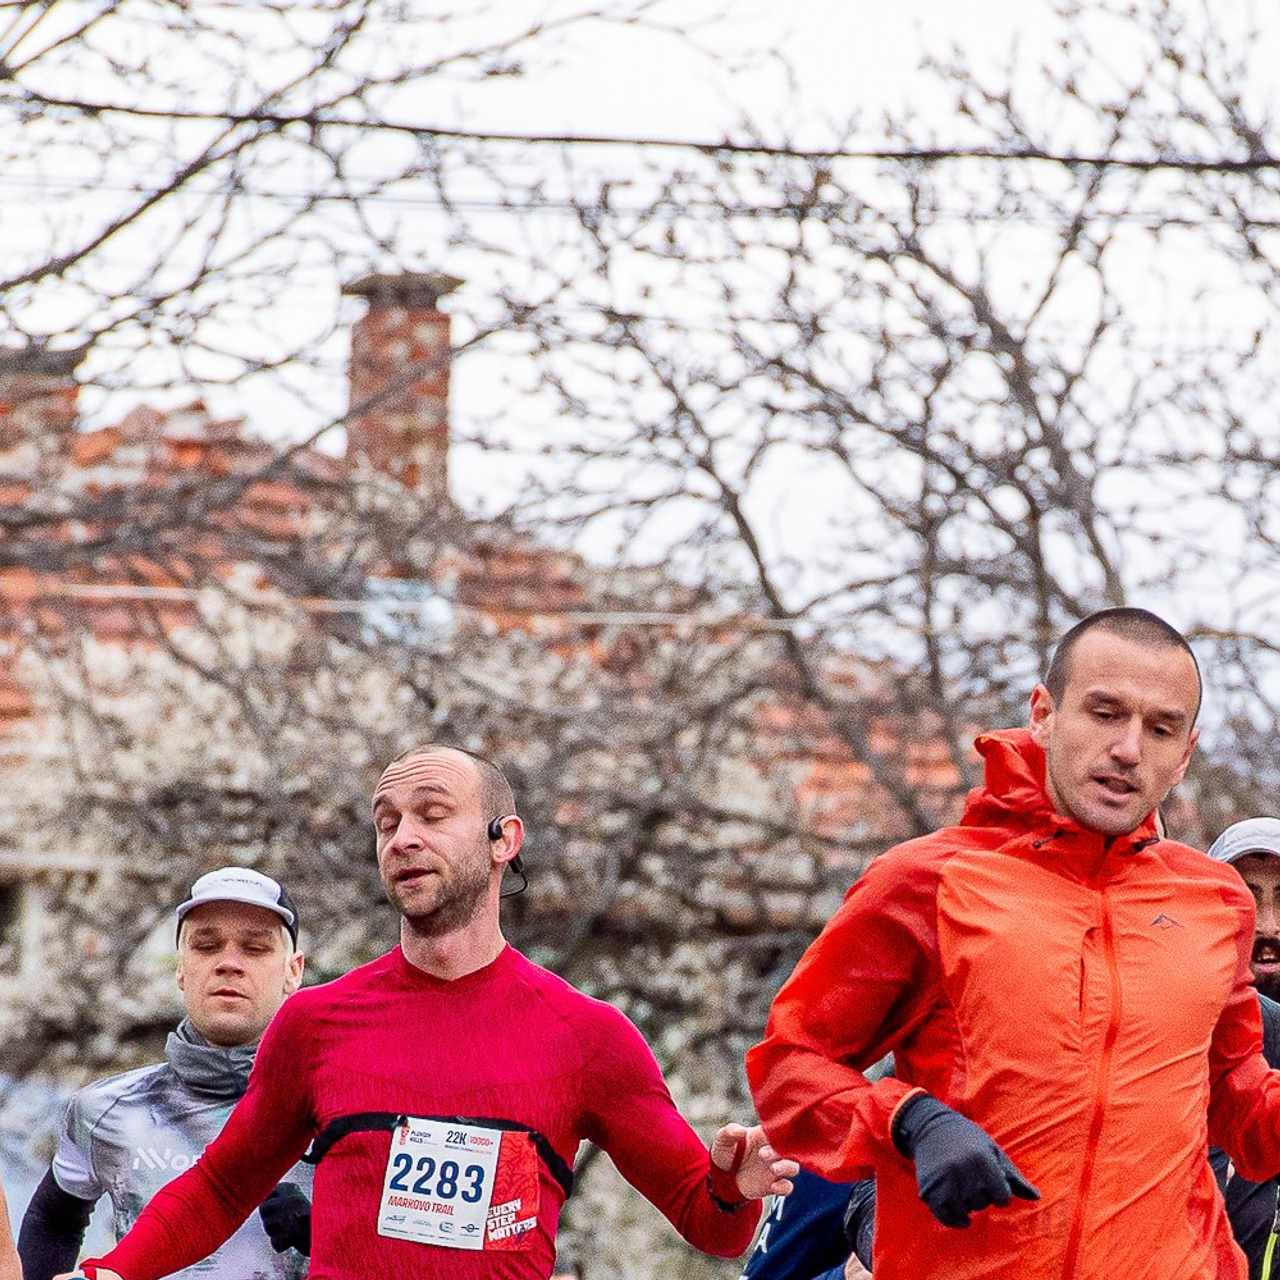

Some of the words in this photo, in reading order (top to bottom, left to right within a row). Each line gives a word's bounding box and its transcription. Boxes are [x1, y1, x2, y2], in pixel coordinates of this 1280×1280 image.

[446, 1130, 467, 1146] 22K
[389, 1153, 485, 1203] 2283
[388, 1196, 430, 1212] MARKOVO
[432, 1203, 455, 1215] TRAIL
[488, 1199, 522, 1218] EVERY
[487, 1213, 516, 1229] STEP
